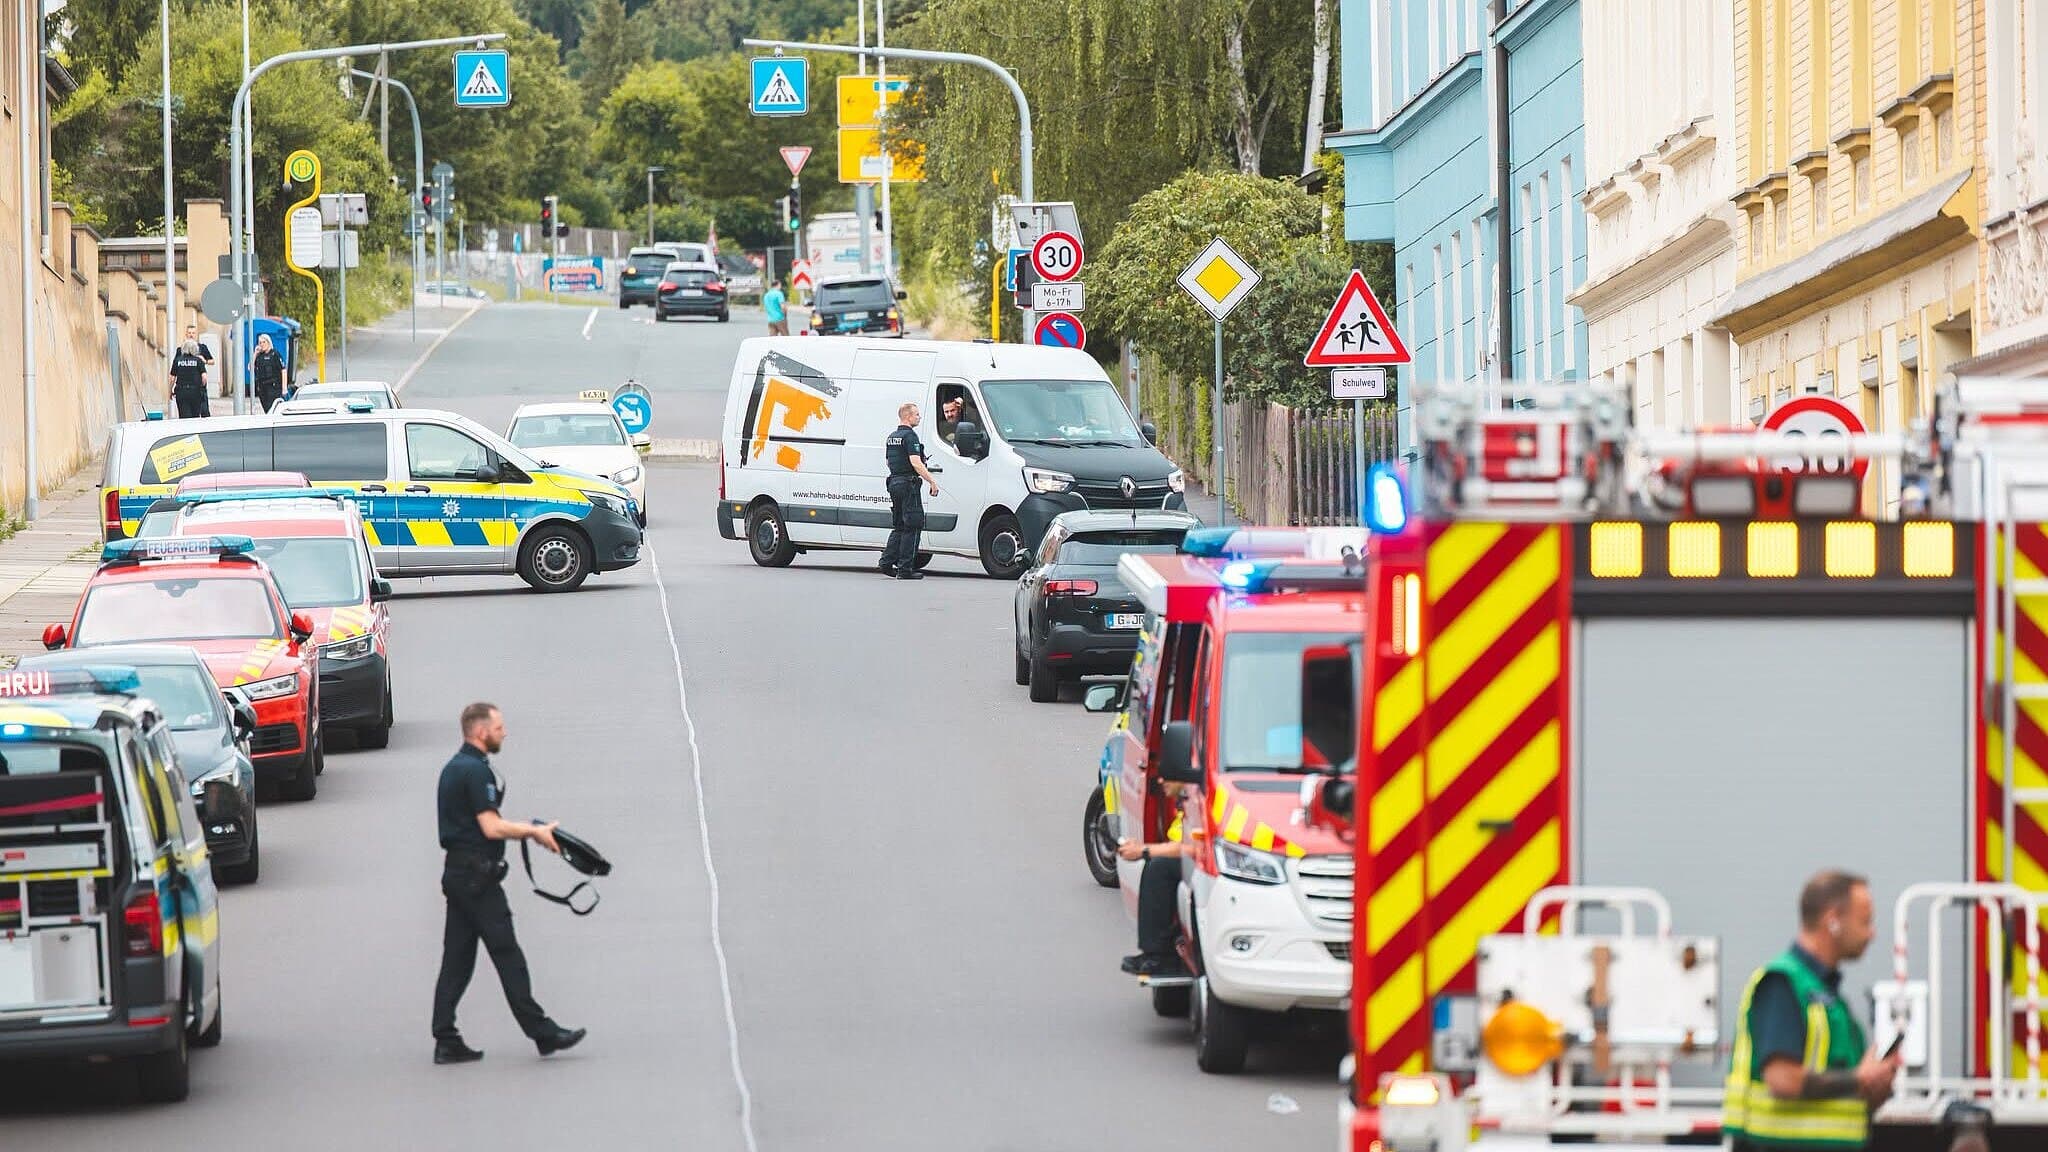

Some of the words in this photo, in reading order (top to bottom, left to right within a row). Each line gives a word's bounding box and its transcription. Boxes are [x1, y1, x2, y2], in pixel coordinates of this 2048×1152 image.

[1043, 246, 1072, 268] 30
[1043, 287, 1073, 297] Mo-Fr
[1342, 378, 1376, 389] Schulweg
[792, 490, 893, 504] www.hahn-bau-abdichtungstec
[148, 540, 208, 556] FEUERWEHR
[1117, 614, 1125, 625] G
